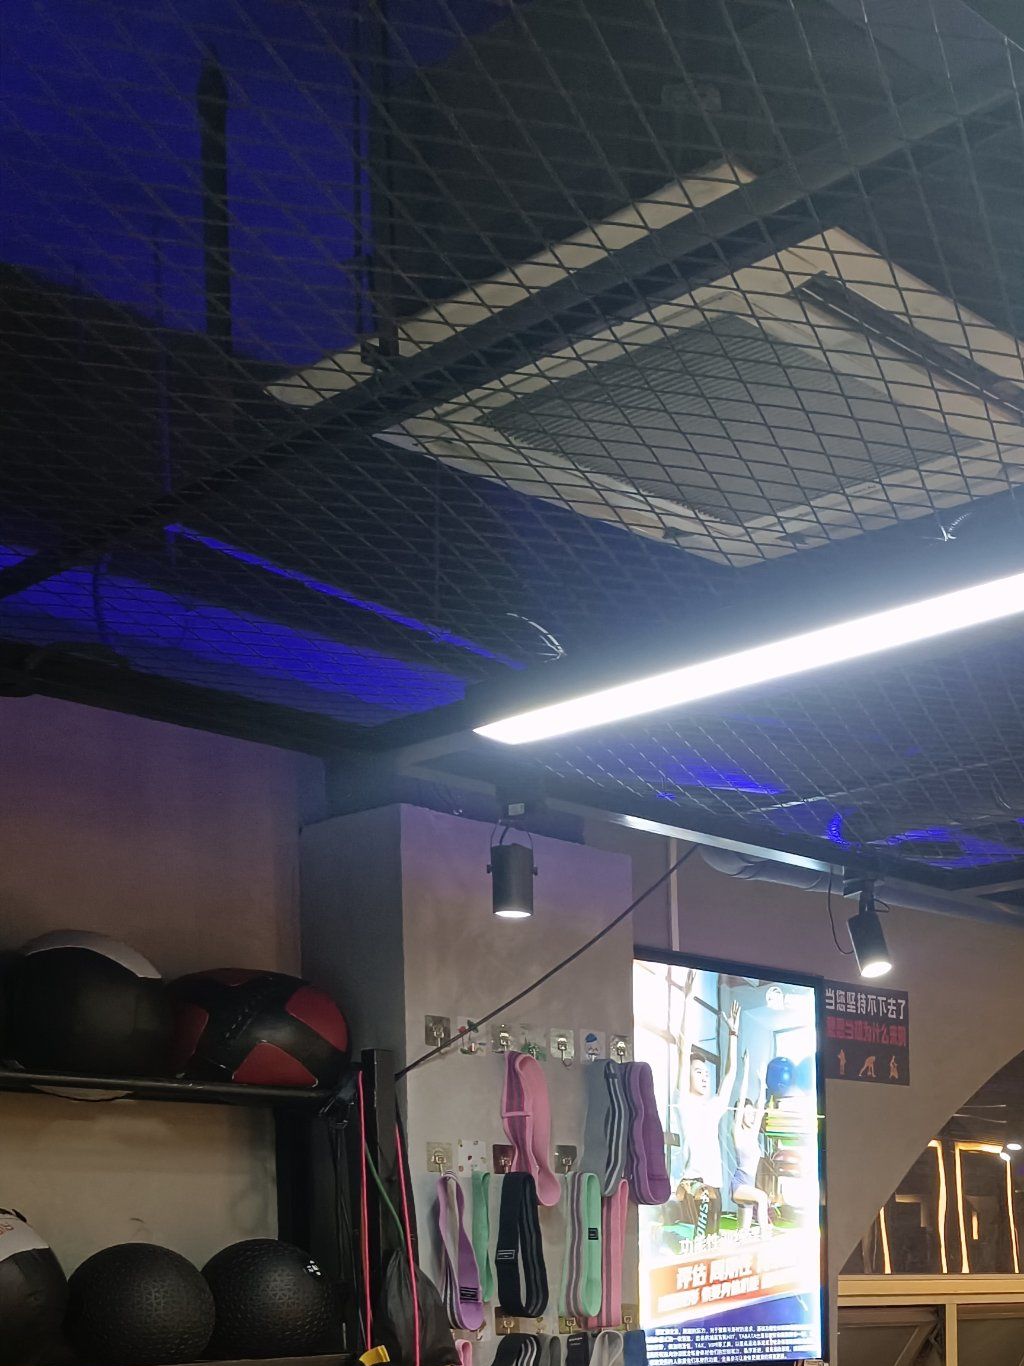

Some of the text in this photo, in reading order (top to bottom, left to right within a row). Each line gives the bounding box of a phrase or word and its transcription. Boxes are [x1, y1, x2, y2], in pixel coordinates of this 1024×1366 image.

[825, 988, 906, 1020] 当您坚持不下去了
